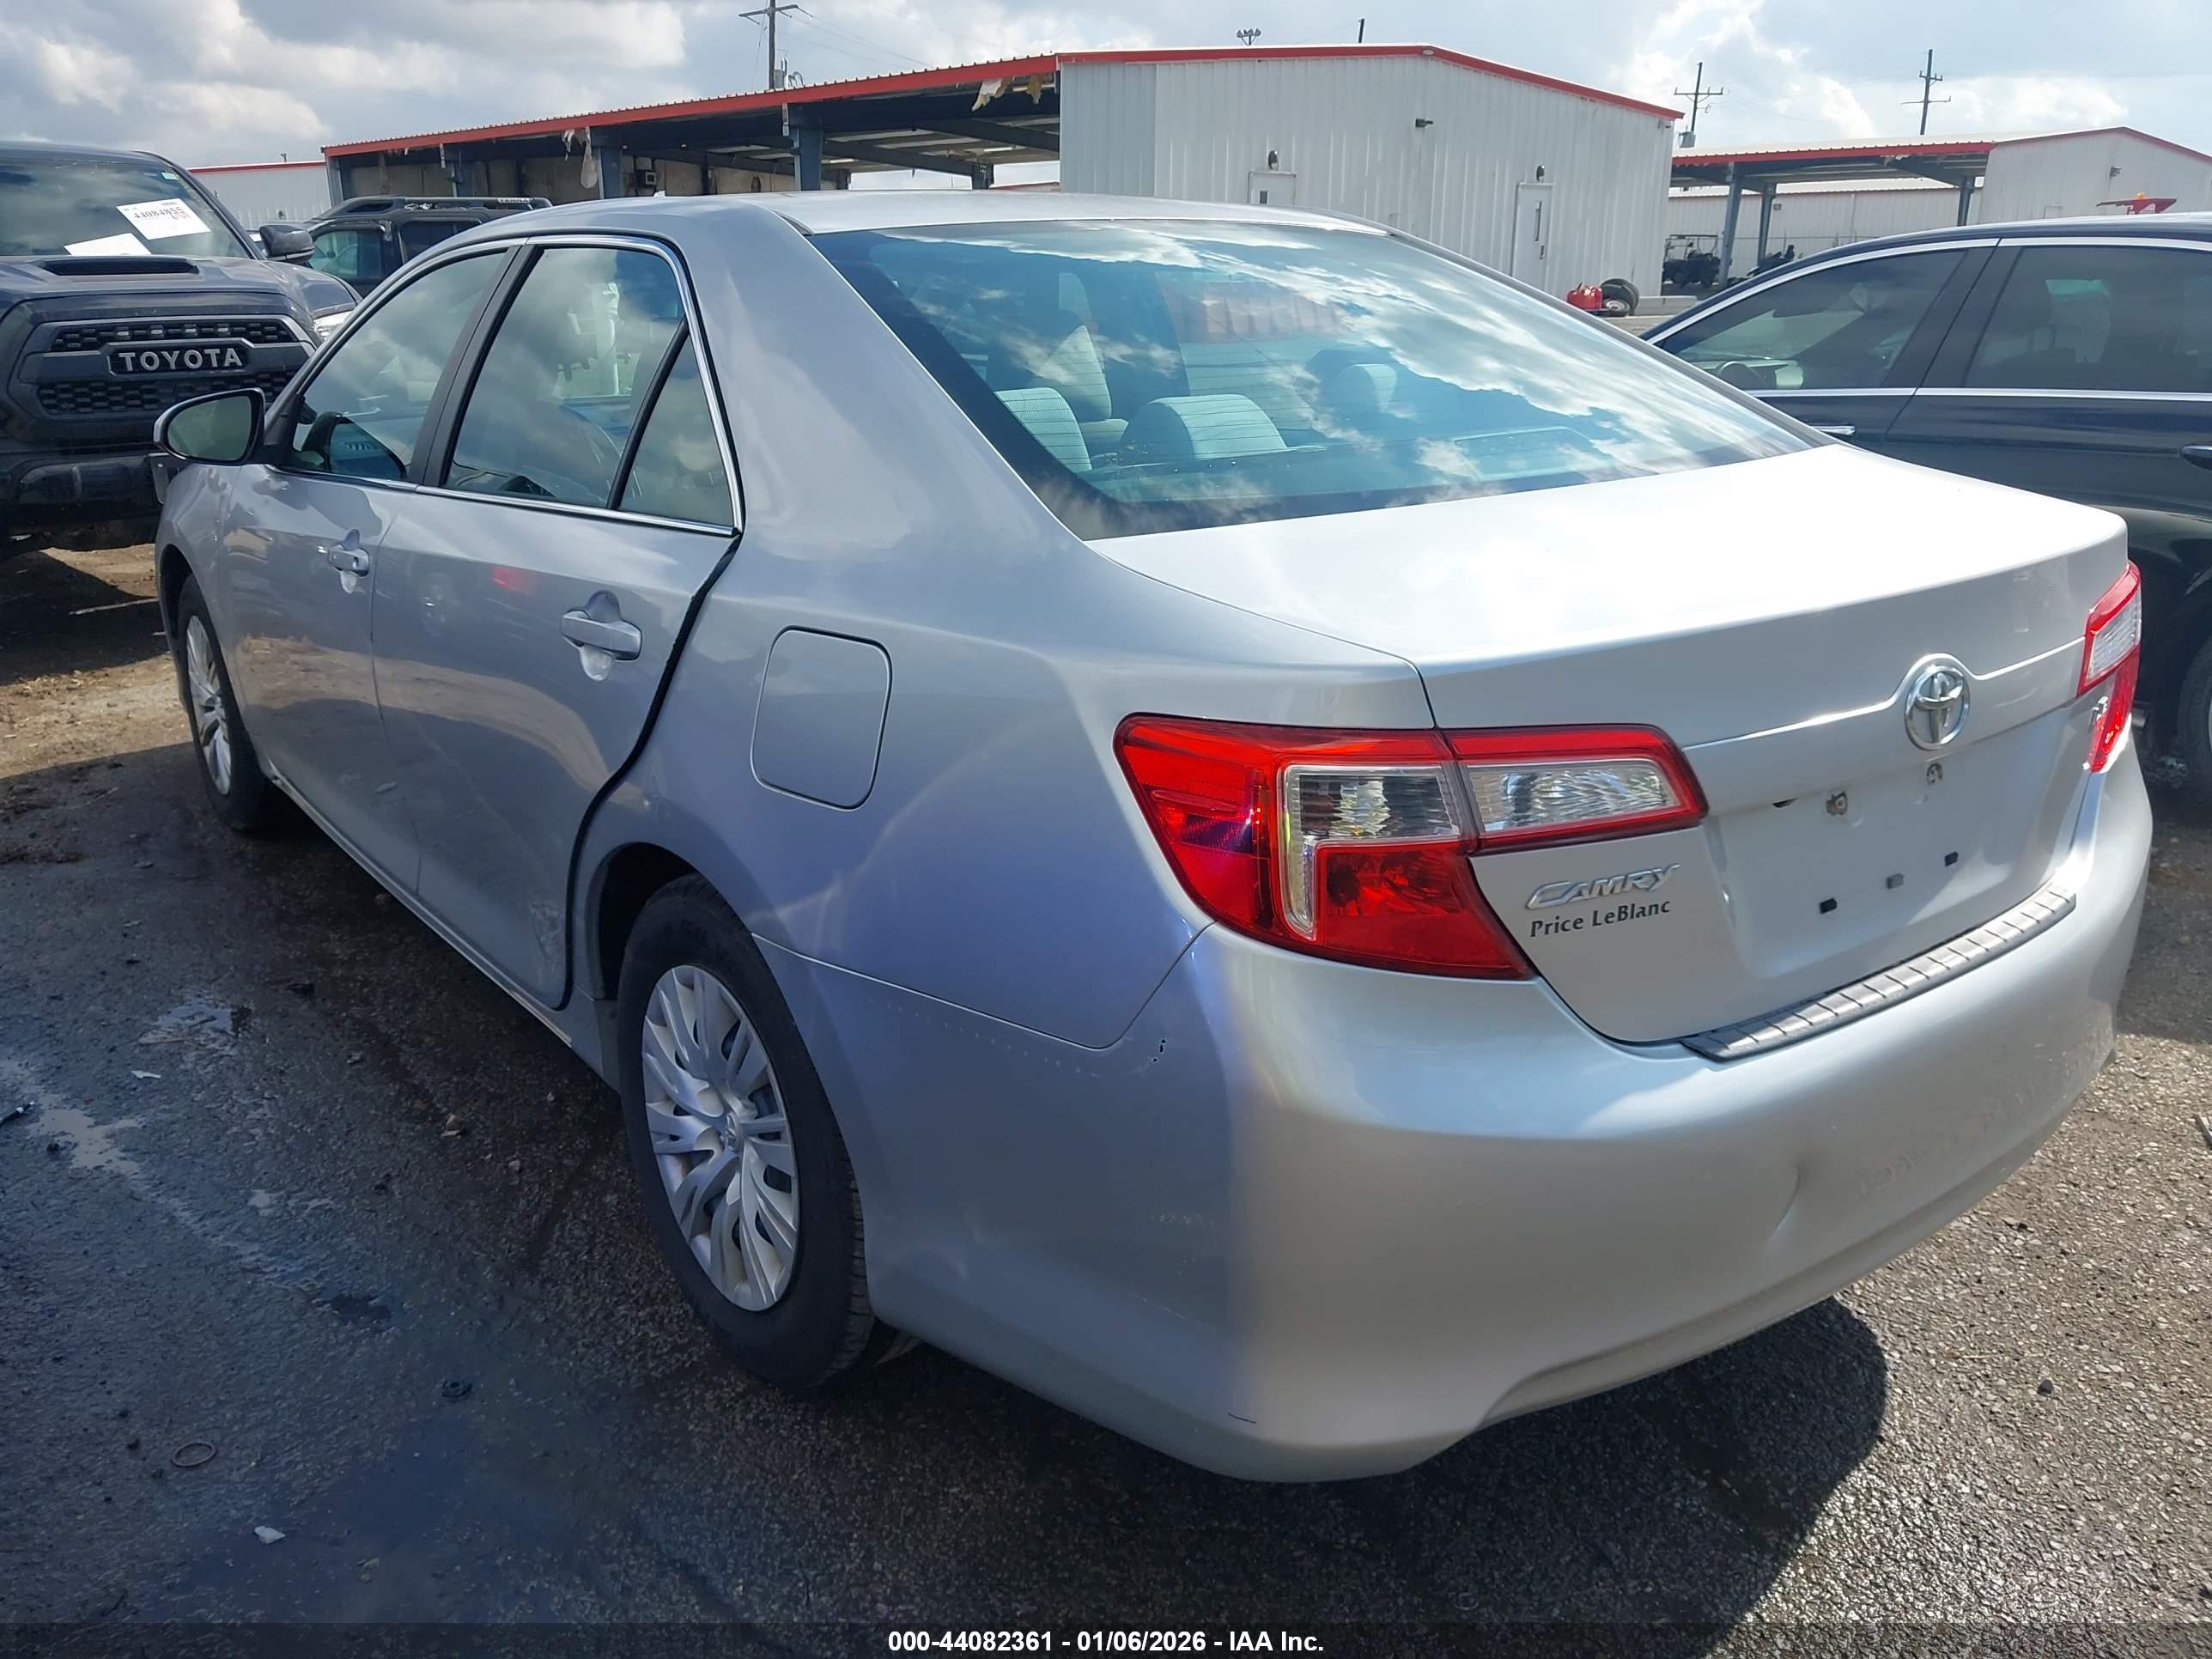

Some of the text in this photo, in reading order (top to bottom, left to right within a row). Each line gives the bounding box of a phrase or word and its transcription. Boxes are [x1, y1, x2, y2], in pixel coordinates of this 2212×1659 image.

[118, 348, 243, 372] TOYOTA
[1525, 863, 1680, 910] CAMRY
[1529, 901, 1670, 938] Price LeBlanc
